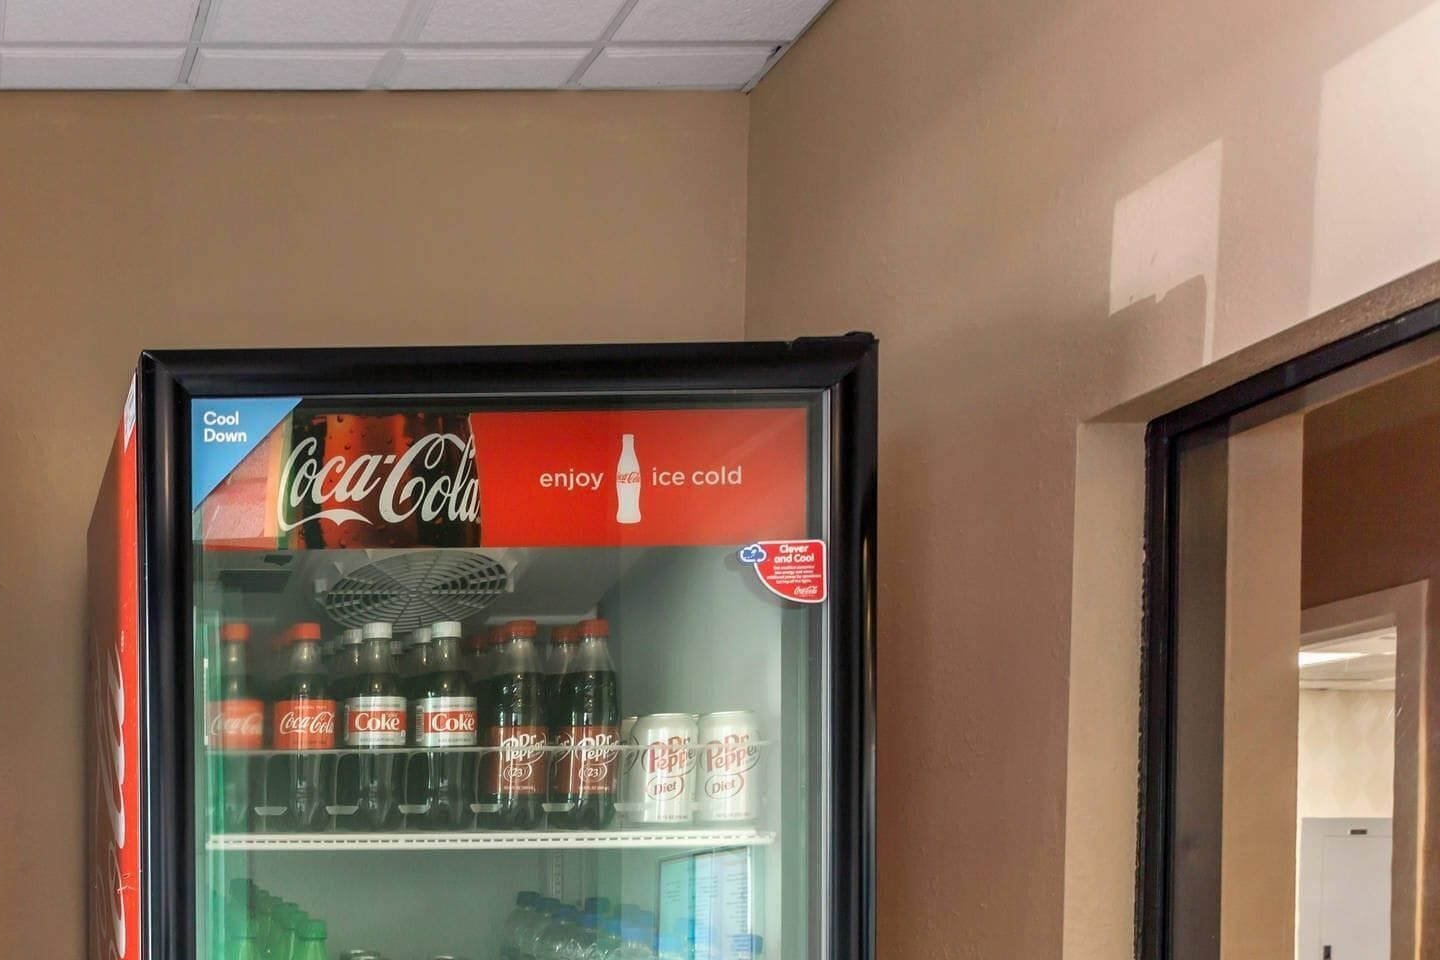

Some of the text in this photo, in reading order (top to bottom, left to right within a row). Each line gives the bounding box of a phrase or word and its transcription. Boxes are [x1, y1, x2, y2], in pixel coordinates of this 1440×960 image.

[204, 411, 239, 425] Cool
[204, 428, 247, 442] Down
[277, 433, 480, 531] Coca-Cola
[540, 469, 604, 490] enjoy
[652, 467, 685, 486] ice
[692, 466, 742, 486] cold
[780, 545, 809, 553] Clever
[774, 553, 815, 563] and Cool
[355, 712, 401, 731] Coke
[431, 713, 475, 731] Coke
[520, 734, 536, 748] Dr
[595, 734, 612, 748] Dr
[654, 782, 677, 795] Diet
[712, 780, 735, 795] Diet
